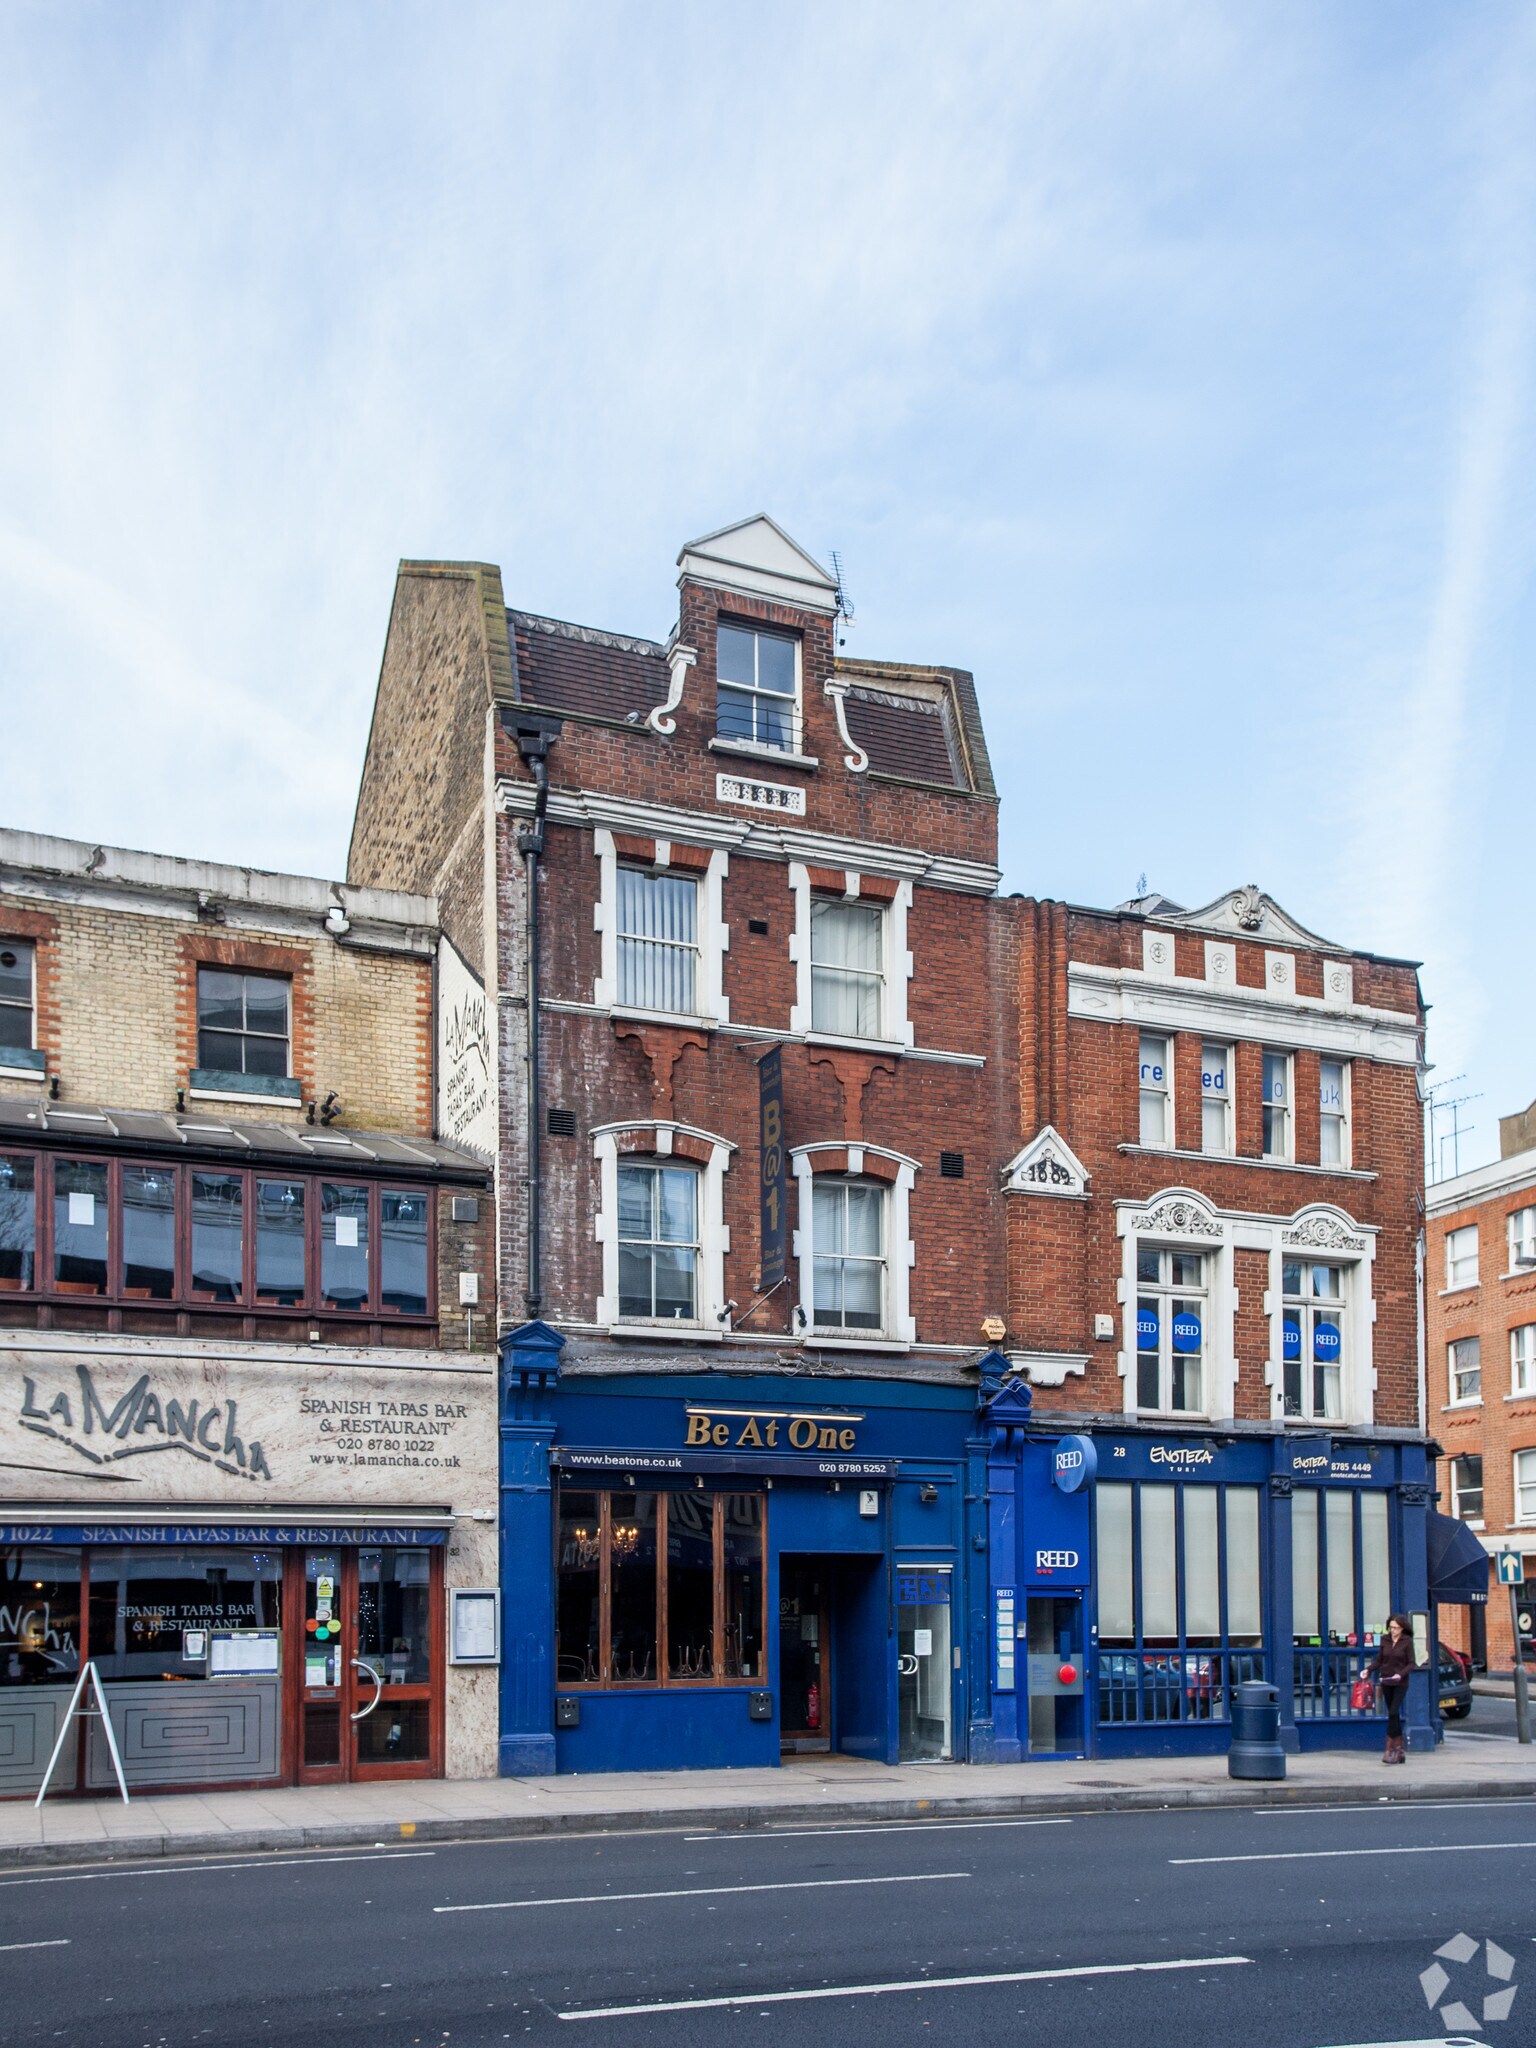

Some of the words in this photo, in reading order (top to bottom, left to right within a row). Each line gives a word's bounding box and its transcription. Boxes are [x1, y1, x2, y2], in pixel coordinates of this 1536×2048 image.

[464, 1077, 475, 1102] BAR
[1174, 1324, 1198, 1336] REED
[1283, 1332, 1298, 1343] EED
[1316, 1334, 1338, 1346] REED
[300, 1399, 371, 1415] SPANISH
[378, 1402, 428, 1416] TAPAS
[435, 1404, 467, 1418] BAR
[320, 1418, 333, 1432] &
[340, 1419, 450, 1435] RESTAURANT
[684, 1415, 729, 1446] Be
[735, 1417, 779, 1448] At
[788, 1418, 856, 1450] One
[337, 1438, 363, 1450] 020
[367, 1439, 400, 1450] 8780
[405, 1440, 435, 1452] 1022
[1113, 1447, 1126, 1457] 28
[310, 1453, 461, 1468] www.lamancha.co.uk
[571, 1455, 682, 1468] www.beatone.co.uk
[1056, 1450, 1082, 1469] REED
[819, 1463, 836, 1473] 020
[838, 1464, 861, 1473] 8780
[863, 1464, 886, 1474] 5252
[1331, 1462, 1349, 1471] 8785
[1351, 1463, 1371, 1472] 4449
[11, 1526, 53, 1541] 1022
[82, 1526, 167, 1541] SPANISH
[172, 1527, 230, 1542] TAPAS
[234, 1528, 270, 1542] BAR
[275, 1528, 290, 1542] &
[294, 1528, 420, 1544] RESTAURANT
[1036, 1550, 1078, 1568] REED
[996, 1589, 1014, 1597] REED
[117, 1605, 176, 1617] SPANISH
[181, 1604, 224, 1616] TAPAS
[228, 1603, 256, 1615] BAR
[132, 1620, 144, 1632] &
[150, 1618, 242, 1631] RESTAURANT
